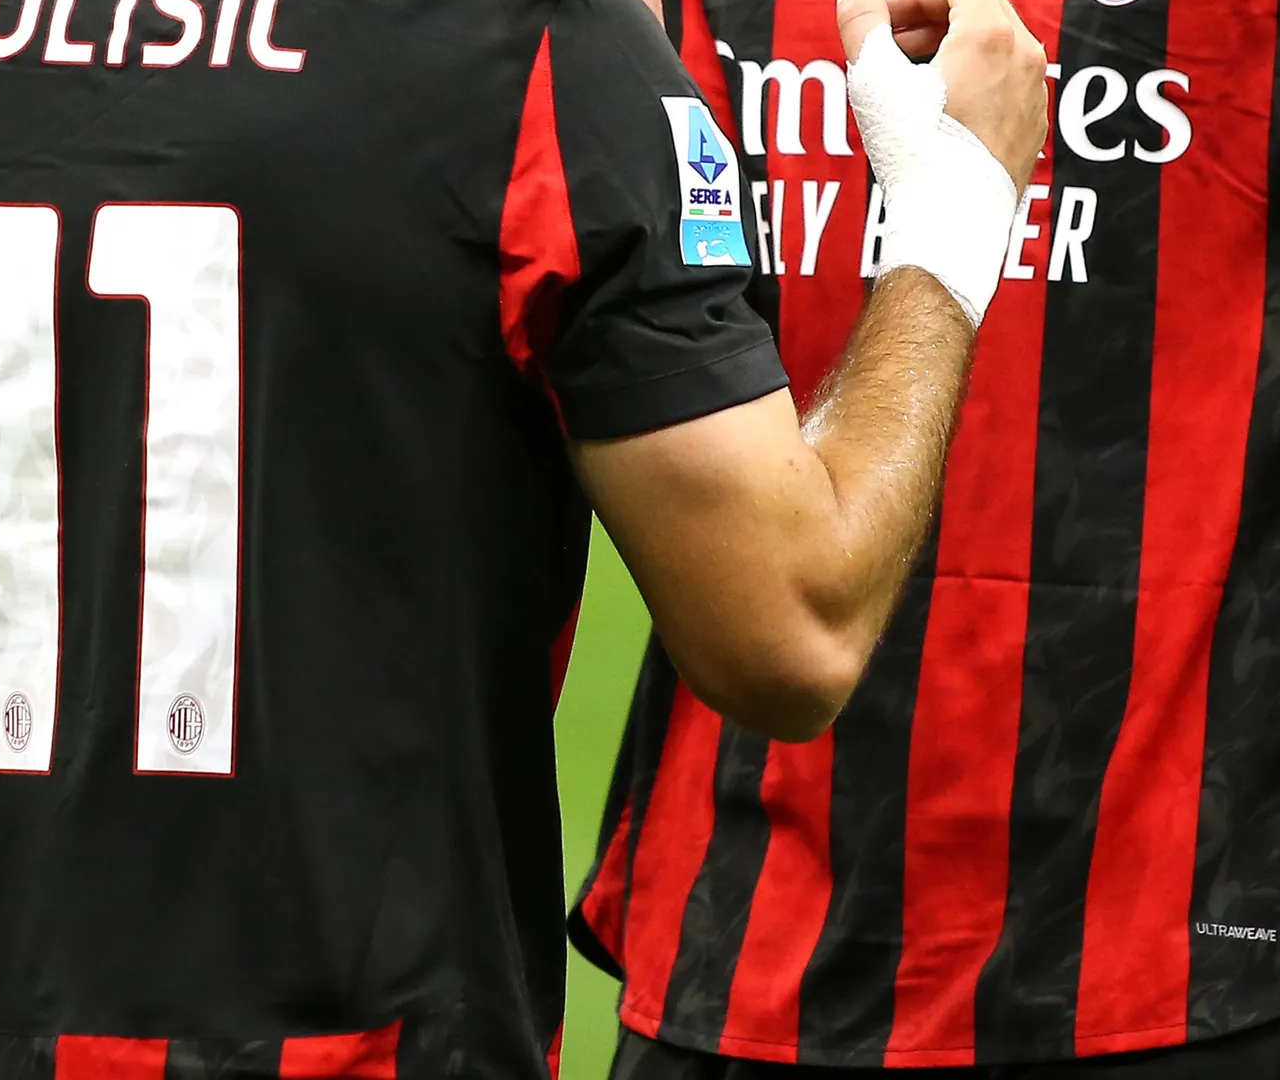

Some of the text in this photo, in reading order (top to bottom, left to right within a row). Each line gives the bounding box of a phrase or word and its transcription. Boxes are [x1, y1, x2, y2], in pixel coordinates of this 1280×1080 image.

[689, 188, 732, 205] SERIE A
[751, 179, 841, 277] FLY
[1196, 922, 1277, 942] ULTRAWEAVE
